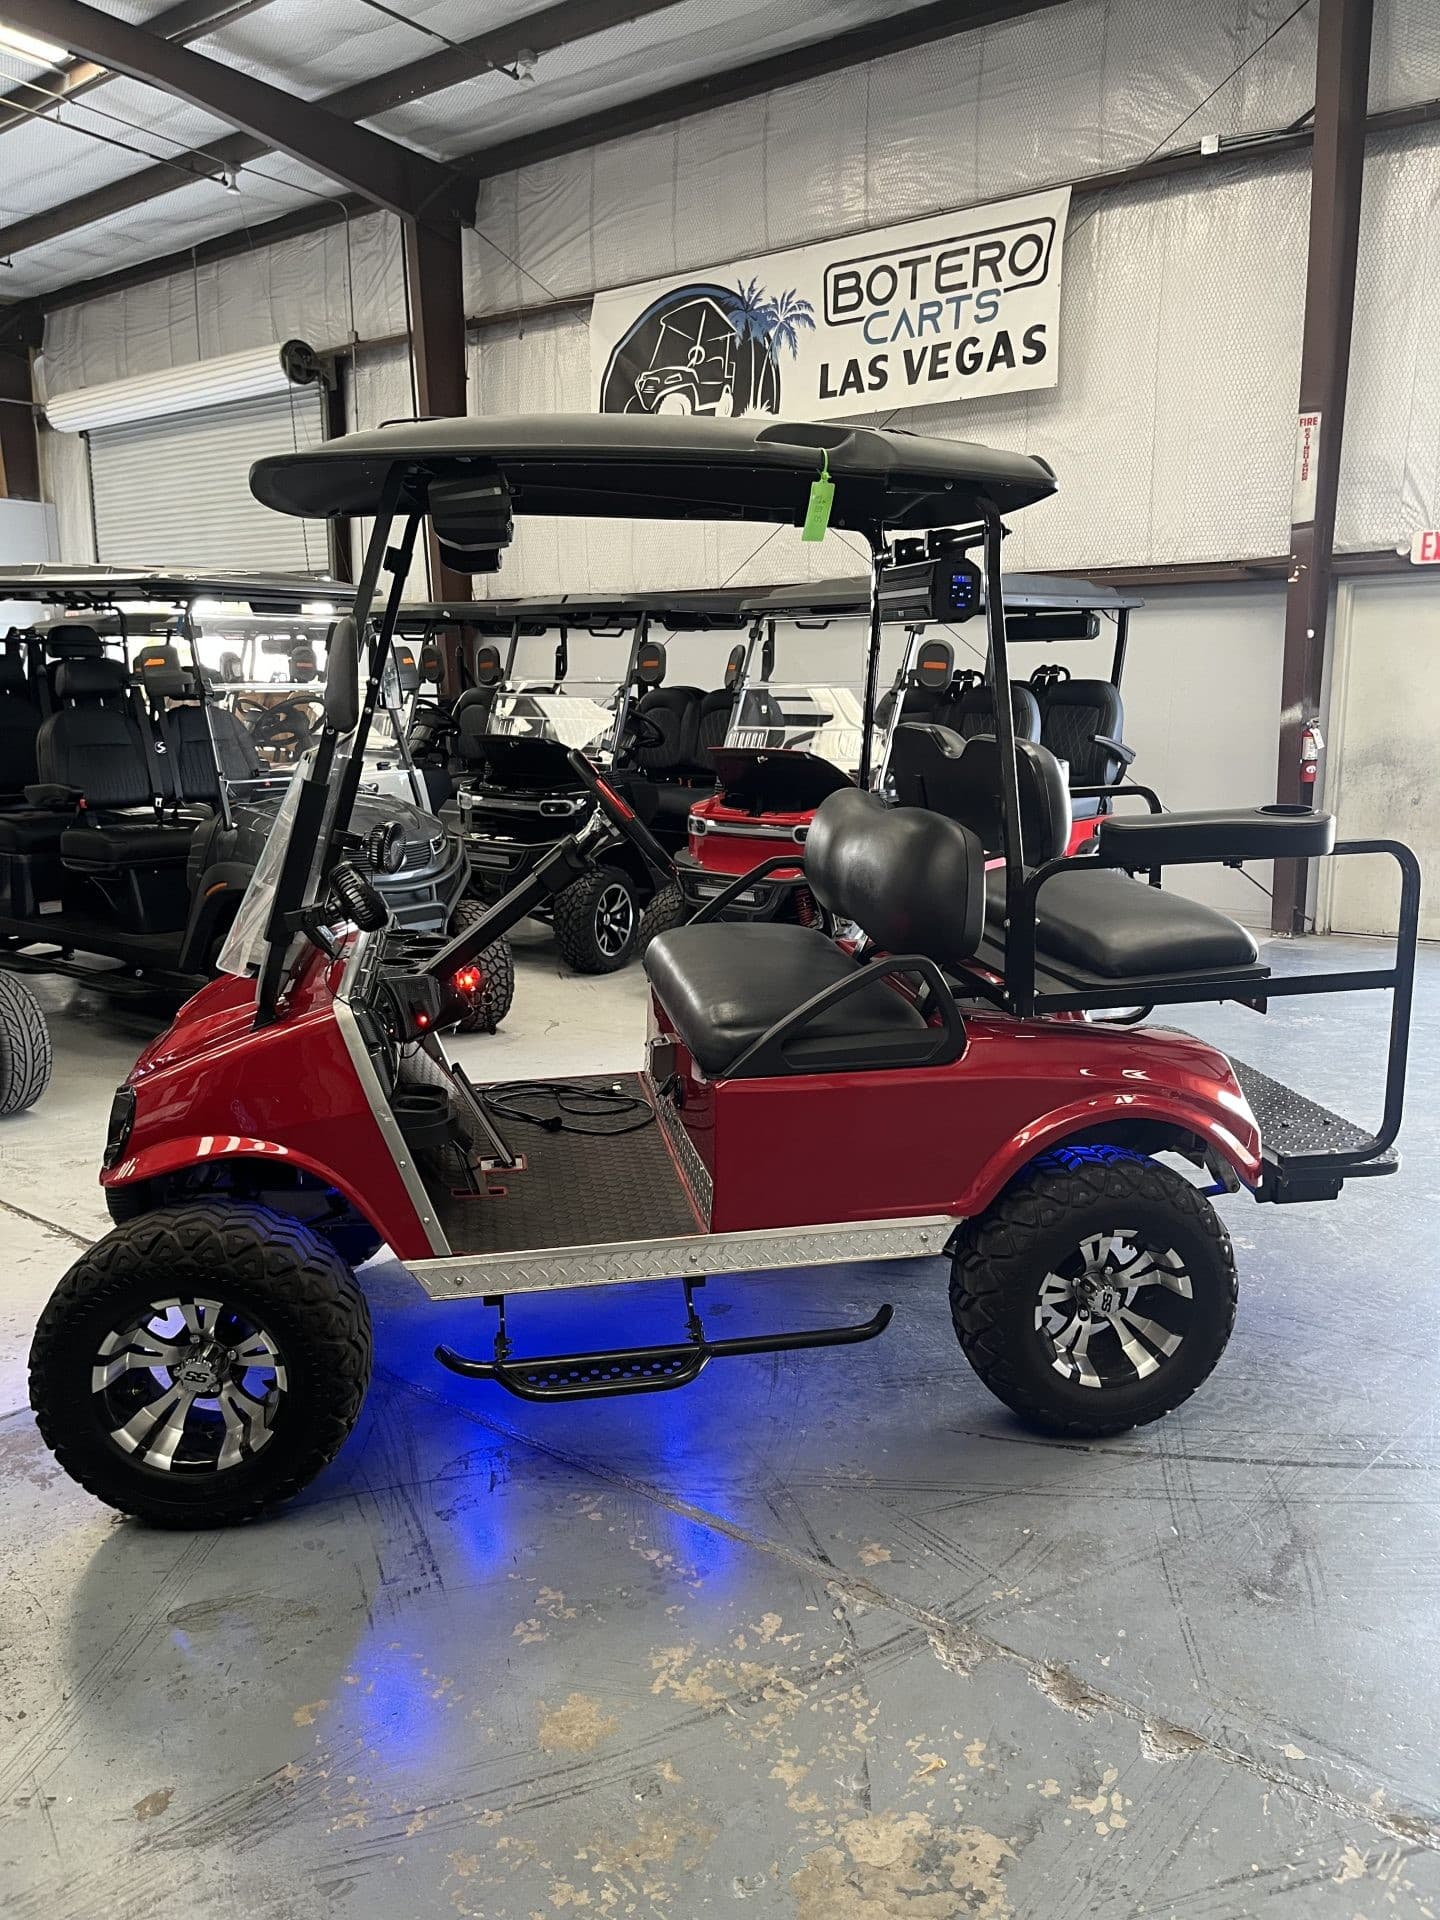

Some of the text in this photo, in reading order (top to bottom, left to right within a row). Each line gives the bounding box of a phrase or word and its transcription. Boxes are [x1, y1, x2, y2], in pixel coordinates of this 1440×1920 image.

[833, 234, 1044, 314] BOTERO
[863, 288, 1001, 345] CARTS
[819, 324, 1047, 399] LAS VEGAS
[1299, 417, 1318, 427] FIRE
[184, 1371, 210, 1383] SS
